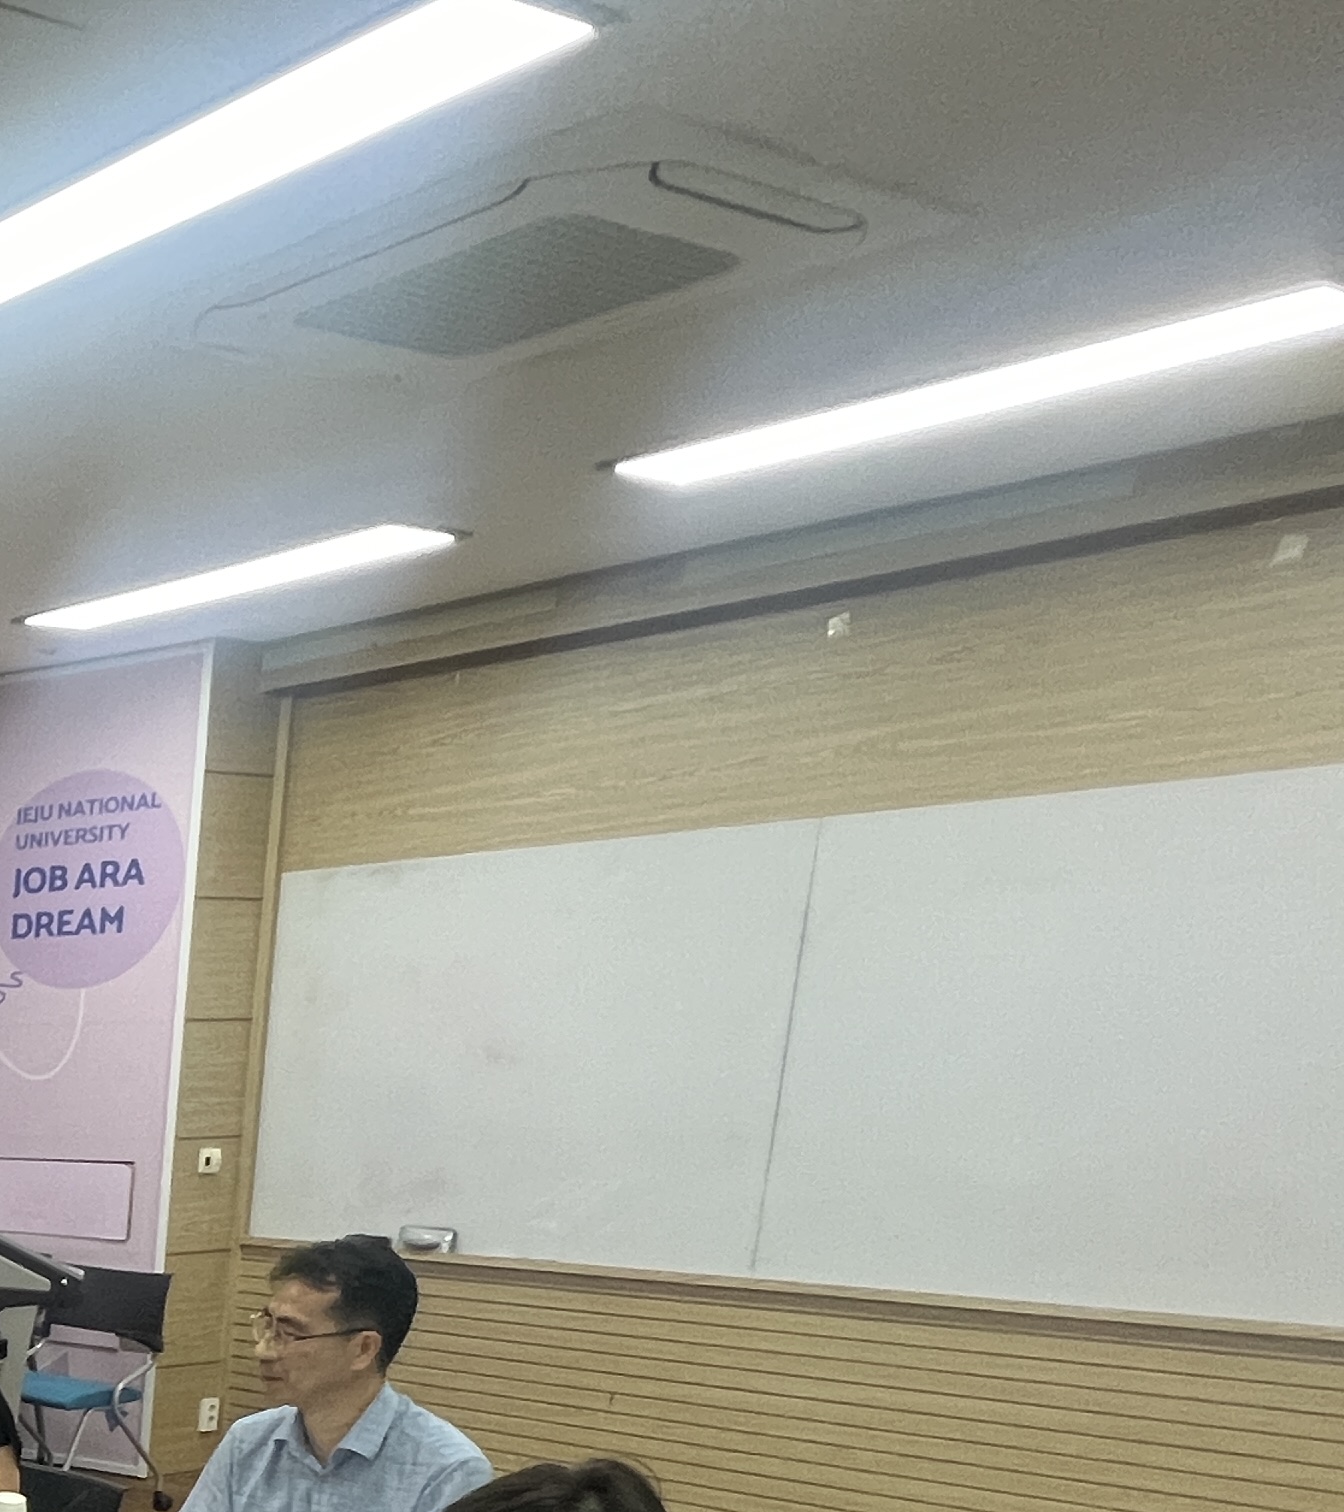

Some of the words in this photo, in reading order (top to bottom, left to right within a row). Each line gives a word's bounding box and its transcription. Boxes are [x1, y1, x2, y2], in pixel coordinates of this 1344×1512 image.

[16, 804, 53, 825] JEJU
[58, 792, 162, 819] NATIONAL
[16, 822, 130, 850] UNIVERSITY
[12, 865, 68, 898] JOB
[74, 858, 145, 890] ARA
[11, 905, 125, 939] DREAM
